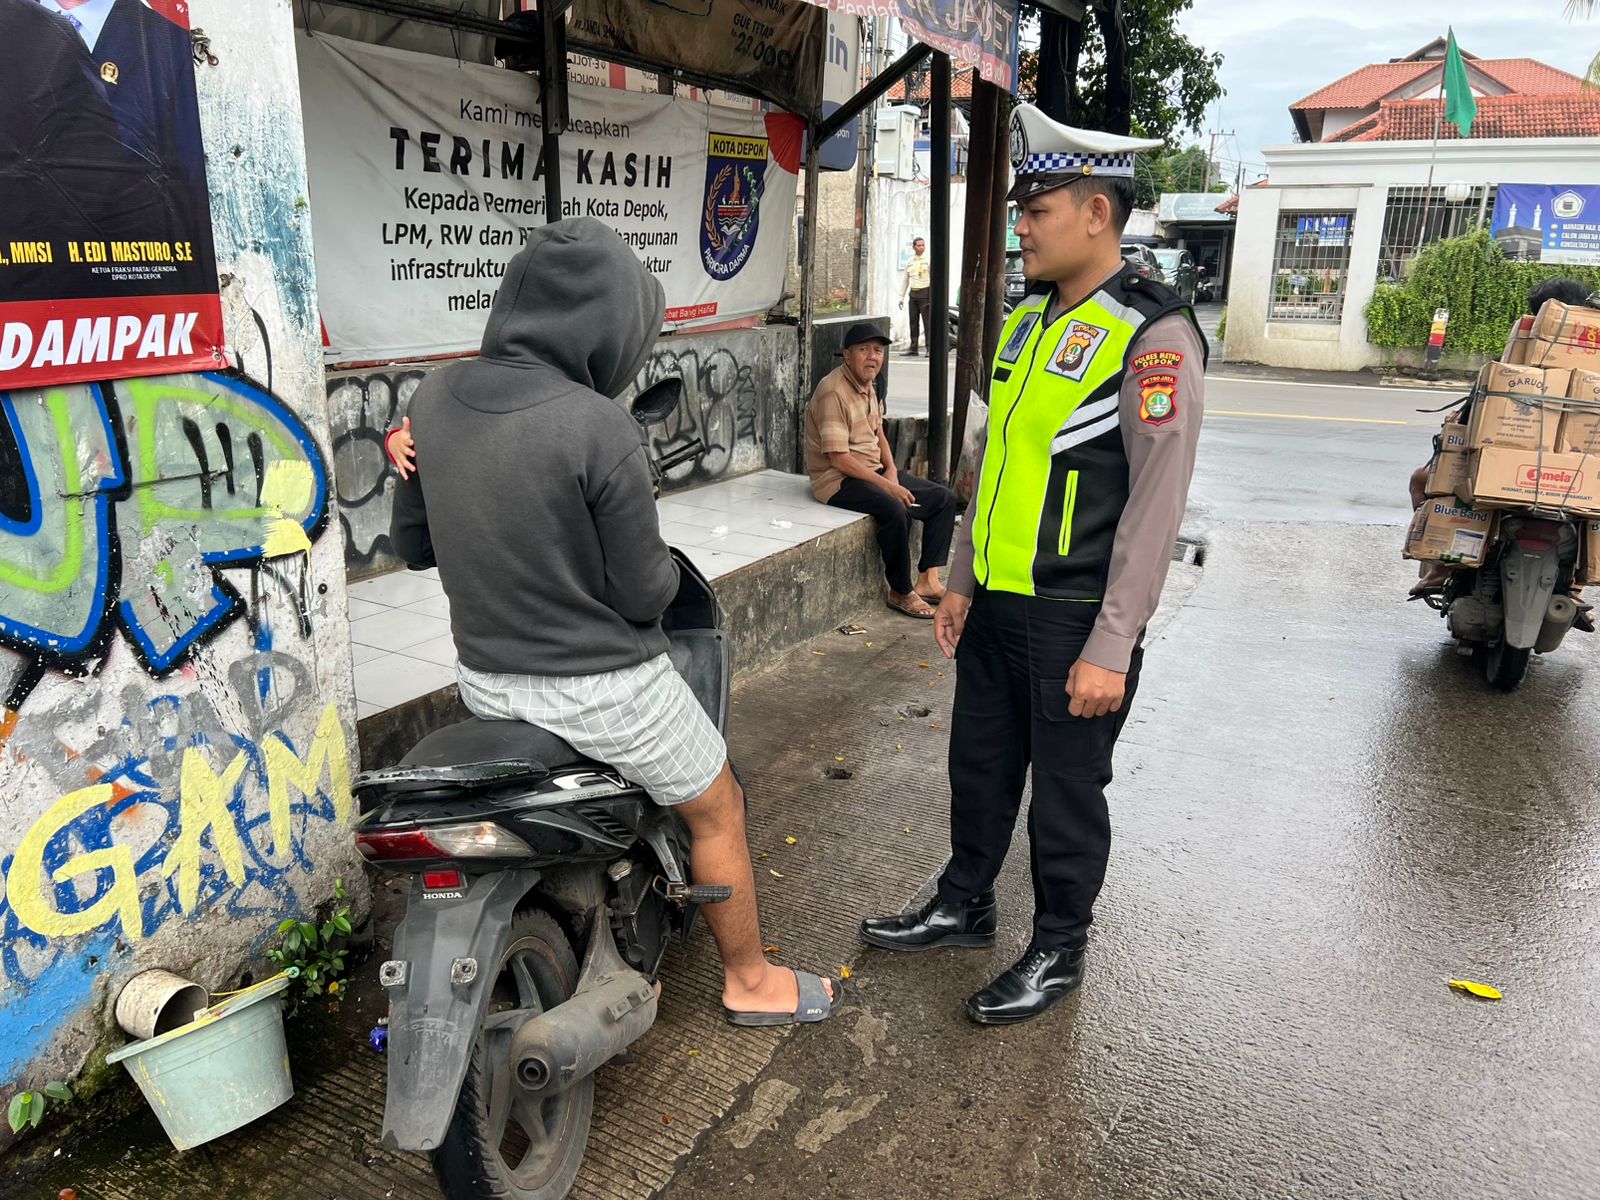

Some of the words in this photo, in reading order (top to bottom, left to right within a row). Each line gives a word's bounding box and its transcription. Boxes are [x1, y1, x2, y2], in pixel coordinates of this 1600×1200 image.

[733, 13, 752, 30] GUE
[826, 24, 849, 73] in
[460, 98, 508, 125] Kami
[515, 111, 631, 140] meucapkan
[713, 139, 736, 155] KOTA
[737, 142, 764, 157] DEPOK
[576, 148, 672, 188] KASIH
[404, 187, 480, 216] Kepada
[483, 191, 581, 216] Pemeriah
[586, 198, 619, 217] Kota
[623, 199, 669, 221] Depok,
[382, 222, 433, 249] LPM,
[440, 224, 473, 245] RW
[479, 225, 513, 246] dan
[10, 241, 53, 264] MMSI
[110, 241, 174, 263] MASTURO,
[728, 243, 750, 273] DARMA
[91, 266, 111, 274] KETUA
[132, 265, 151, 273] PARTAI
[111, 273, 128, 281] DPRD
[143, 272, 162, 280] DEPOK
[390, 258, 509, 281] infrastruktu
[0, 312, 199, 372] DAMPAK
[1134, 352, 1158, 367] POLRES
[1159, 351, 1181, 362] METRO
[1142, 359, 1173, 368] DEPOK
[1447, 434, 1465, 446] Blu
[1433, 503, 1458, 517] Blue
[1460, 508, 1488, 522] Band
[422, 891, 463, 900] HONDA
